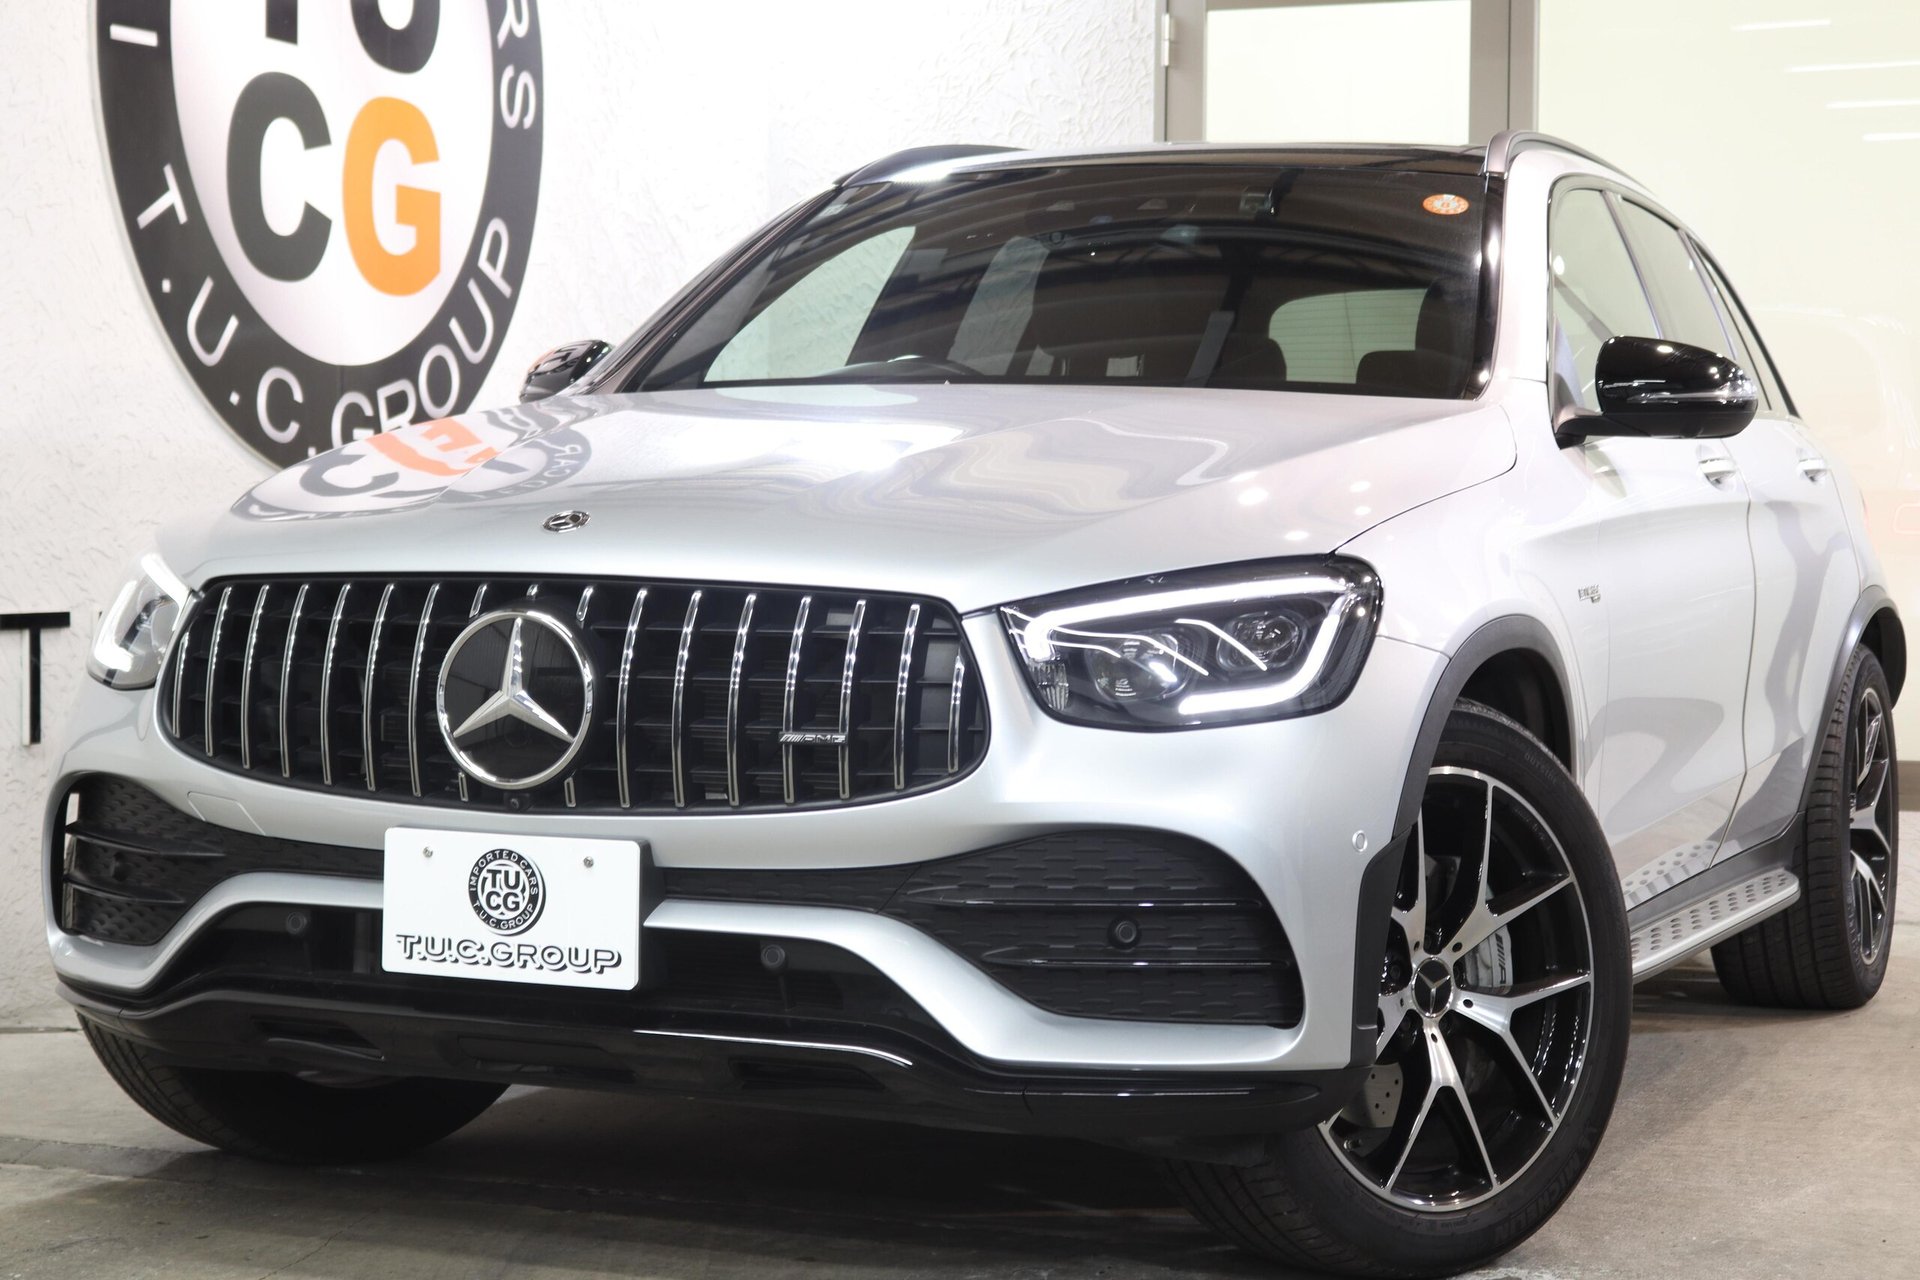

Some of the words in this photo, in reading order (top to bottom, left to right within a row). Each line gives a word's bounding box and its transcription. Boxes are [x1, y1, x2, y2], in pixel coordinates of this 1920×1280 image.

[469, 850, 519, 892] IMPORTED
[519, 860, 539, 896] CARS
[485, 868, 521, 890] TU
[485, 890, 521, 912] CG
[396, 934, 622, 975] T.U.C.GROUP
